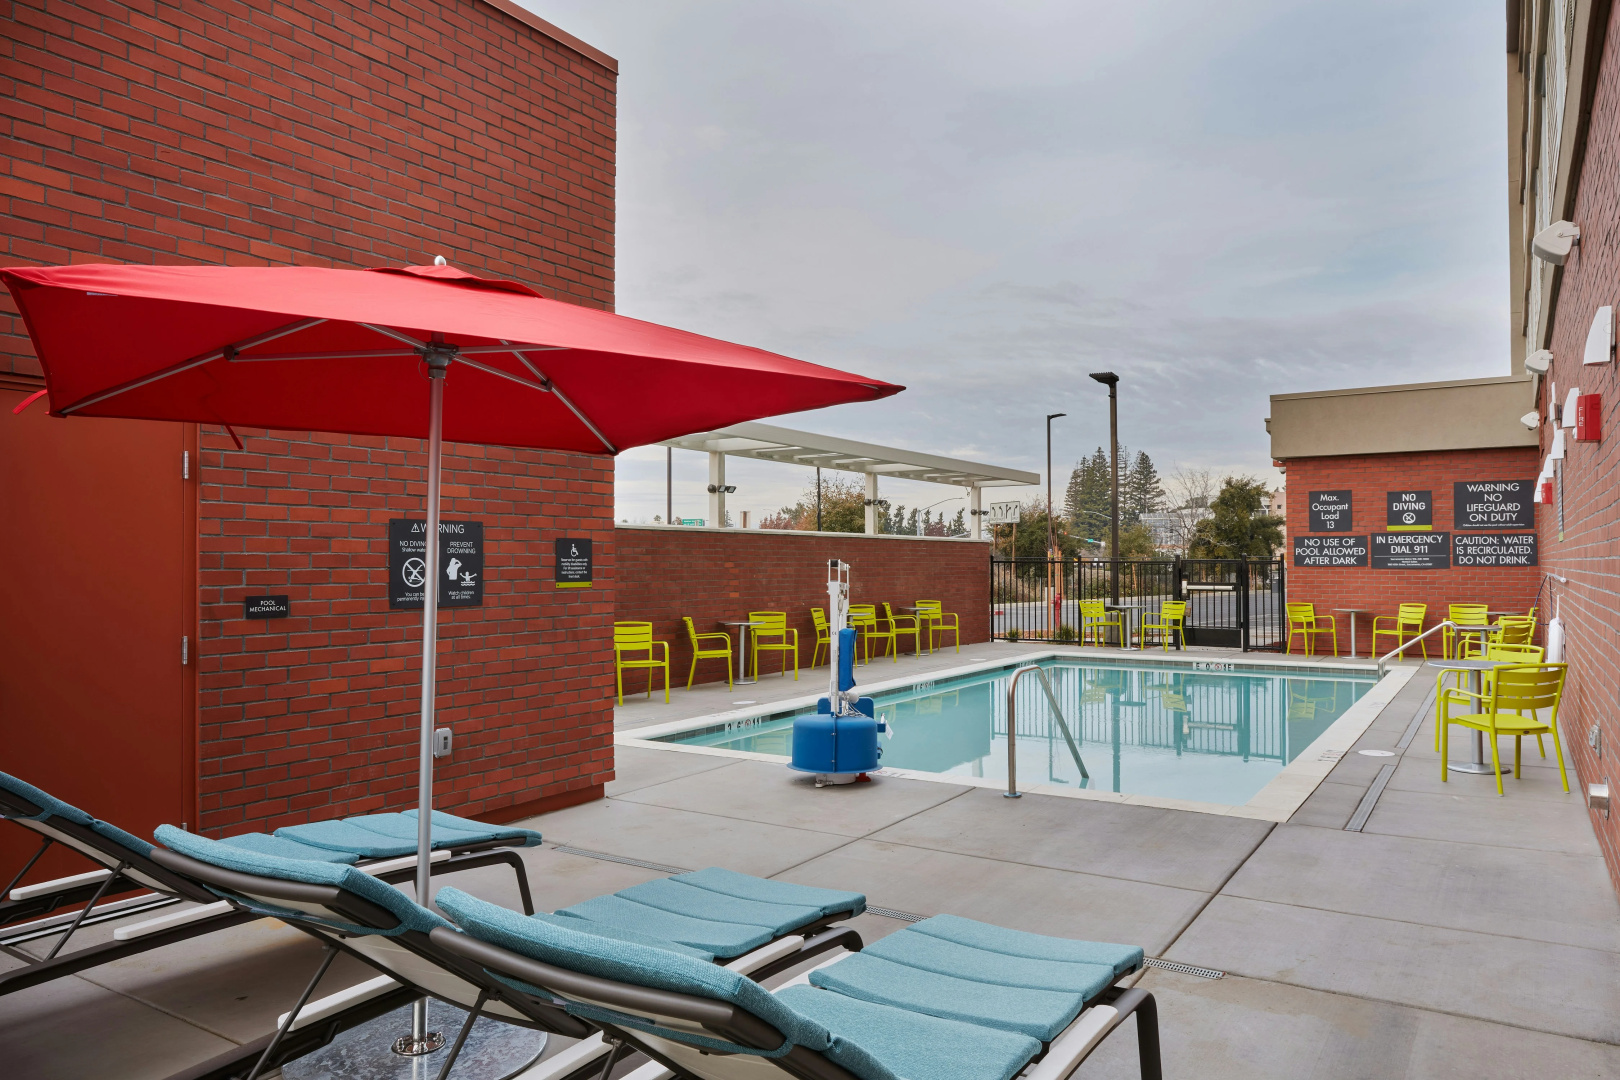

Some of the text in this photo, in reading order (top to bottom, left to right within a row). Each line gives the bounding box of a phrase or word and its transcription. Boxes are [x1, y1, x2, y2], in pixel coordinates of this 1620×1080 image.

[1466, 482, 1520, 493] WARNING
[1319, 493, 1340, 502] Max.
[1401, 493, 1417, 502] NO
[1484, 493, 1503, 502] NO
[1311, 502, 1349, 512] Occupant
[1392, 502, 1426, 510] DIVING
[1466, 502, 1521, 512] LIFEGUARD
[1320, 511, 1340, 520] Load
[1469, 512, 1518, 522] ON DUTY
[1326, 521, 1335, 529] 13
[1304, 537, 1356, 547] NO USE OF
[1376, 534, 1444, 544] IN EMERGENCY
[1455, 535, 1534, 545] CAUTION: WATER
[1295, 547, 1366, 556] POOL ALLOWED
[1390, 545, 1428, 554] DIAL 911
[1456, 545, 1533, 555] IS RECIRCULATED.
[1303, 556, 1357, 565] AFTER DARK
[1458, 555, 1531, 565] DO NOT DRINK.
